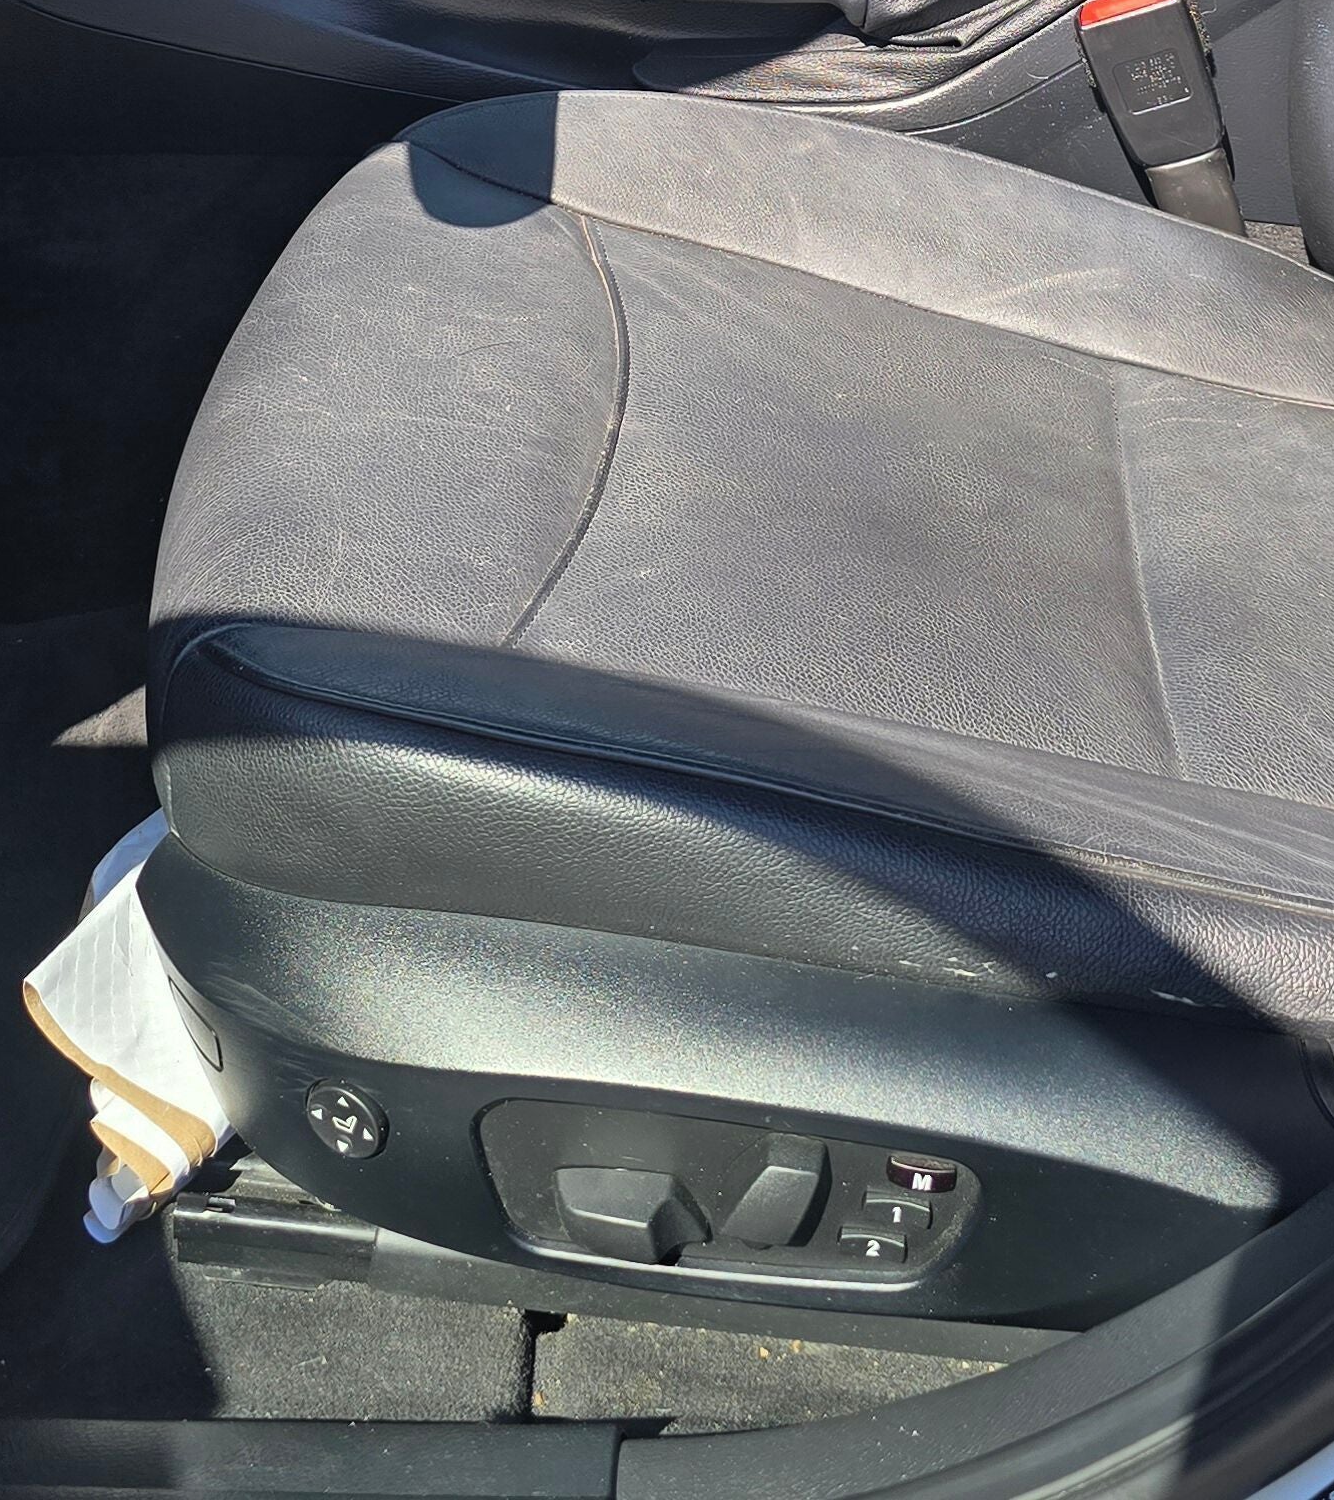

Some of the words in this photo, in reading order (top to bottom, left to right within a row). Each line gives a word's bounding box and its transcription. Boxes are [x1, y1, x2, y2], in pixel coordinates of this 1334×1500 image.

[912, 1172, 932, 1191] M
[892, 1206, 902, 1223] 1
[866, 1239, 880, 1257] 2
